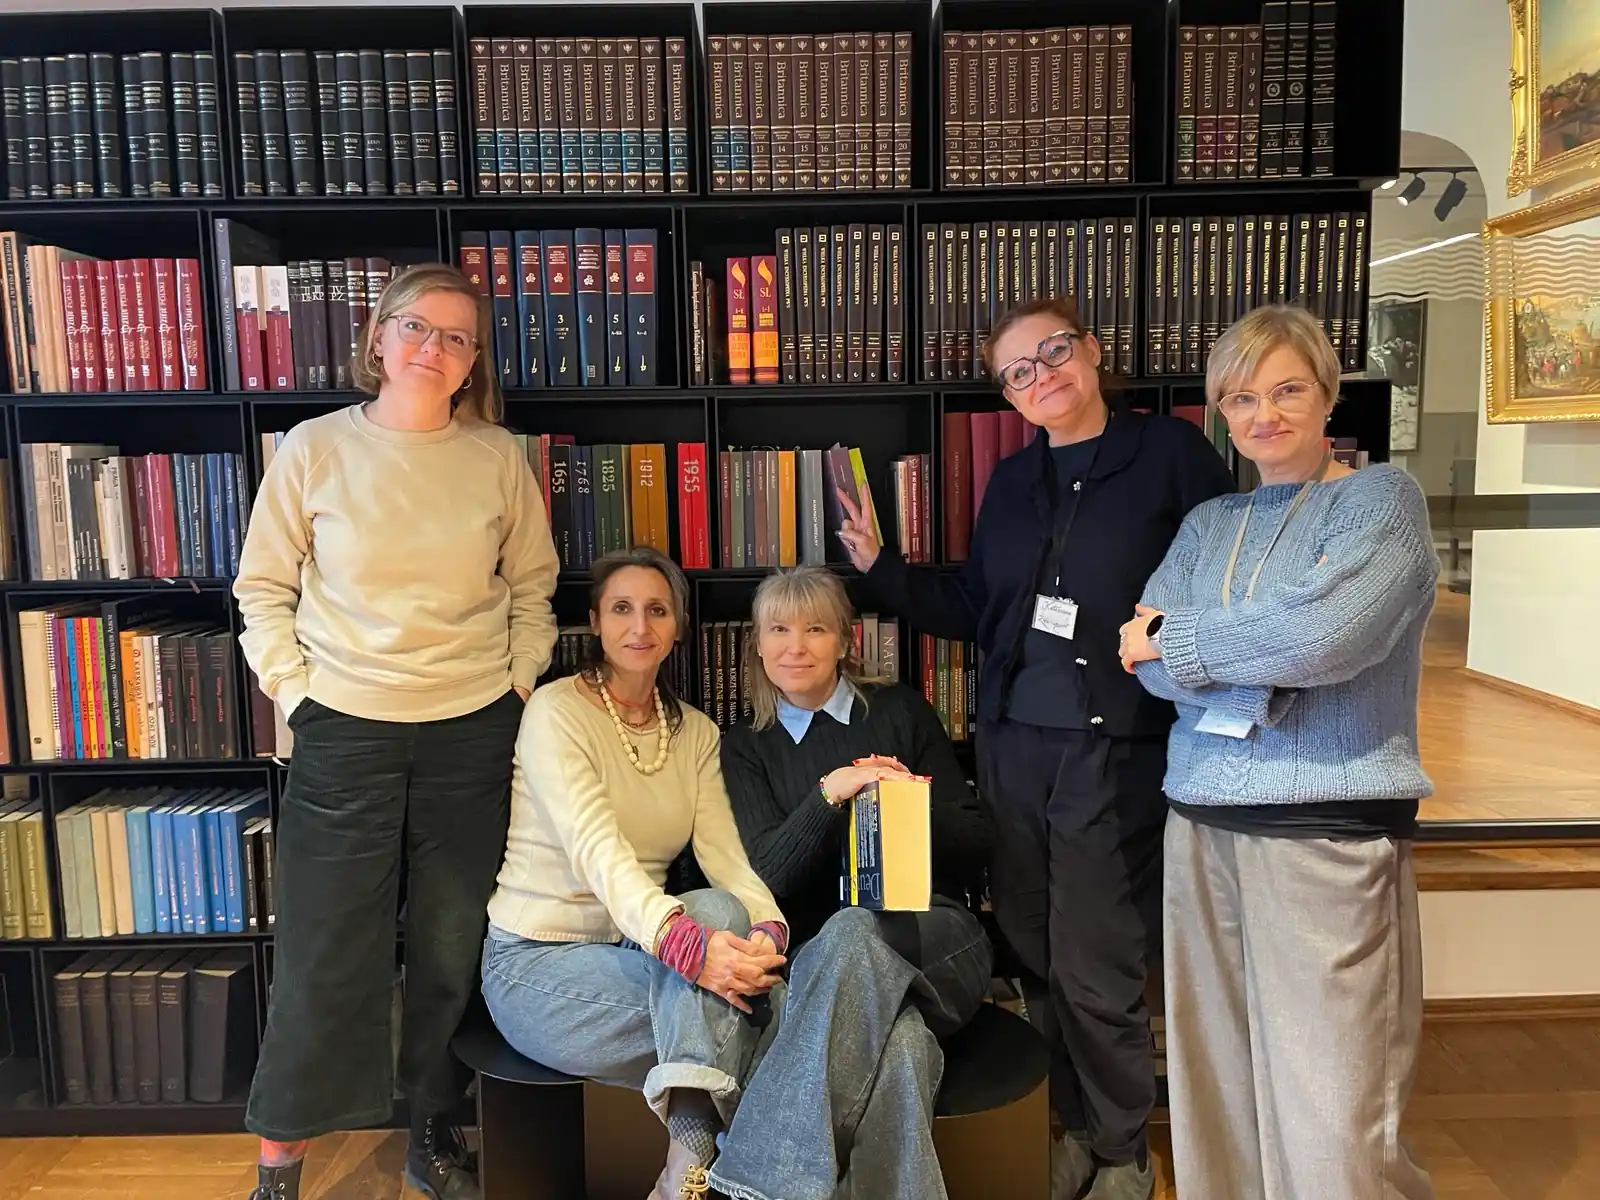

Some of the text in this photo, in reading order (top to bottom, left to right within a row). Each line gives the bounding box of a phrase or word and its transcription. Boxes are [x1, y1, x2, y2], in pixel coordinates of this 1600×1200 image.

[477, 64, 488, 122] Britannica
[500, 64, 511, 122] Britannica
[520, 64, 531, 122] Britannica
[542, 64, 552, 122] Britannica
[564, 64, 574, 122] Britannica
[583, 64, 595, 122] Britannica
[604, 64, 615, 122] Britannica
[625, 64, 636, 122] Britannica
[646, 64, 657, 122] Britannica
[672, 64, 684, 122] Britannica
[713, 62, 724, 119] Britannica
[734, 61, 745, 118] Britannica
[754, 62, 764, 119] Britannica
[777, 62, 787, 119] Britannica
[799, 61, 808, 118] Britannica
[820, 62, 829, 119] Britannica
[840, 60, 849, 117] Britannica
[860, 59, 869, 116] Britannica
[879, 59, 889, 116] Britannica
[899, 59, 908, 116] Britannica
[949, 58, 958, 114] Britannica
[969, 58, 978, 115] Britannica
[988, 57, 997, 114] Britannica
[1009, 57, 1018, 113] Britannica
[1030, 56, 1040, 113] Britannica
[1051, 54, 1061, 110] Britannica
[1073, 53, 1082, 109] Britannica
[1094, 52, 1104, 109] Britannica
[1117, 52, 1127, 109] Britannica
[1183, 52, 1193, 108] Britannica
[1205, 52, 1214, 108] Britannica
[1227, 52, 1237, 108] Britannica
[501, 318, 507, 326] 2
[529, 315, 535, 323] 3
[558, 315, 564, 323] 3
[613, 315, 619, 323] 5
[639, 315, 645, 323] 6
[552, 461, 567, 493] 1655
[575, 460, 589, 494] 1768
[602, 459, 615, 492] 1825
[640, 459, 653, 487] 1912
[684, 459, 699, 492] 1955
[703, 668, 711, 699] KORZENIE
